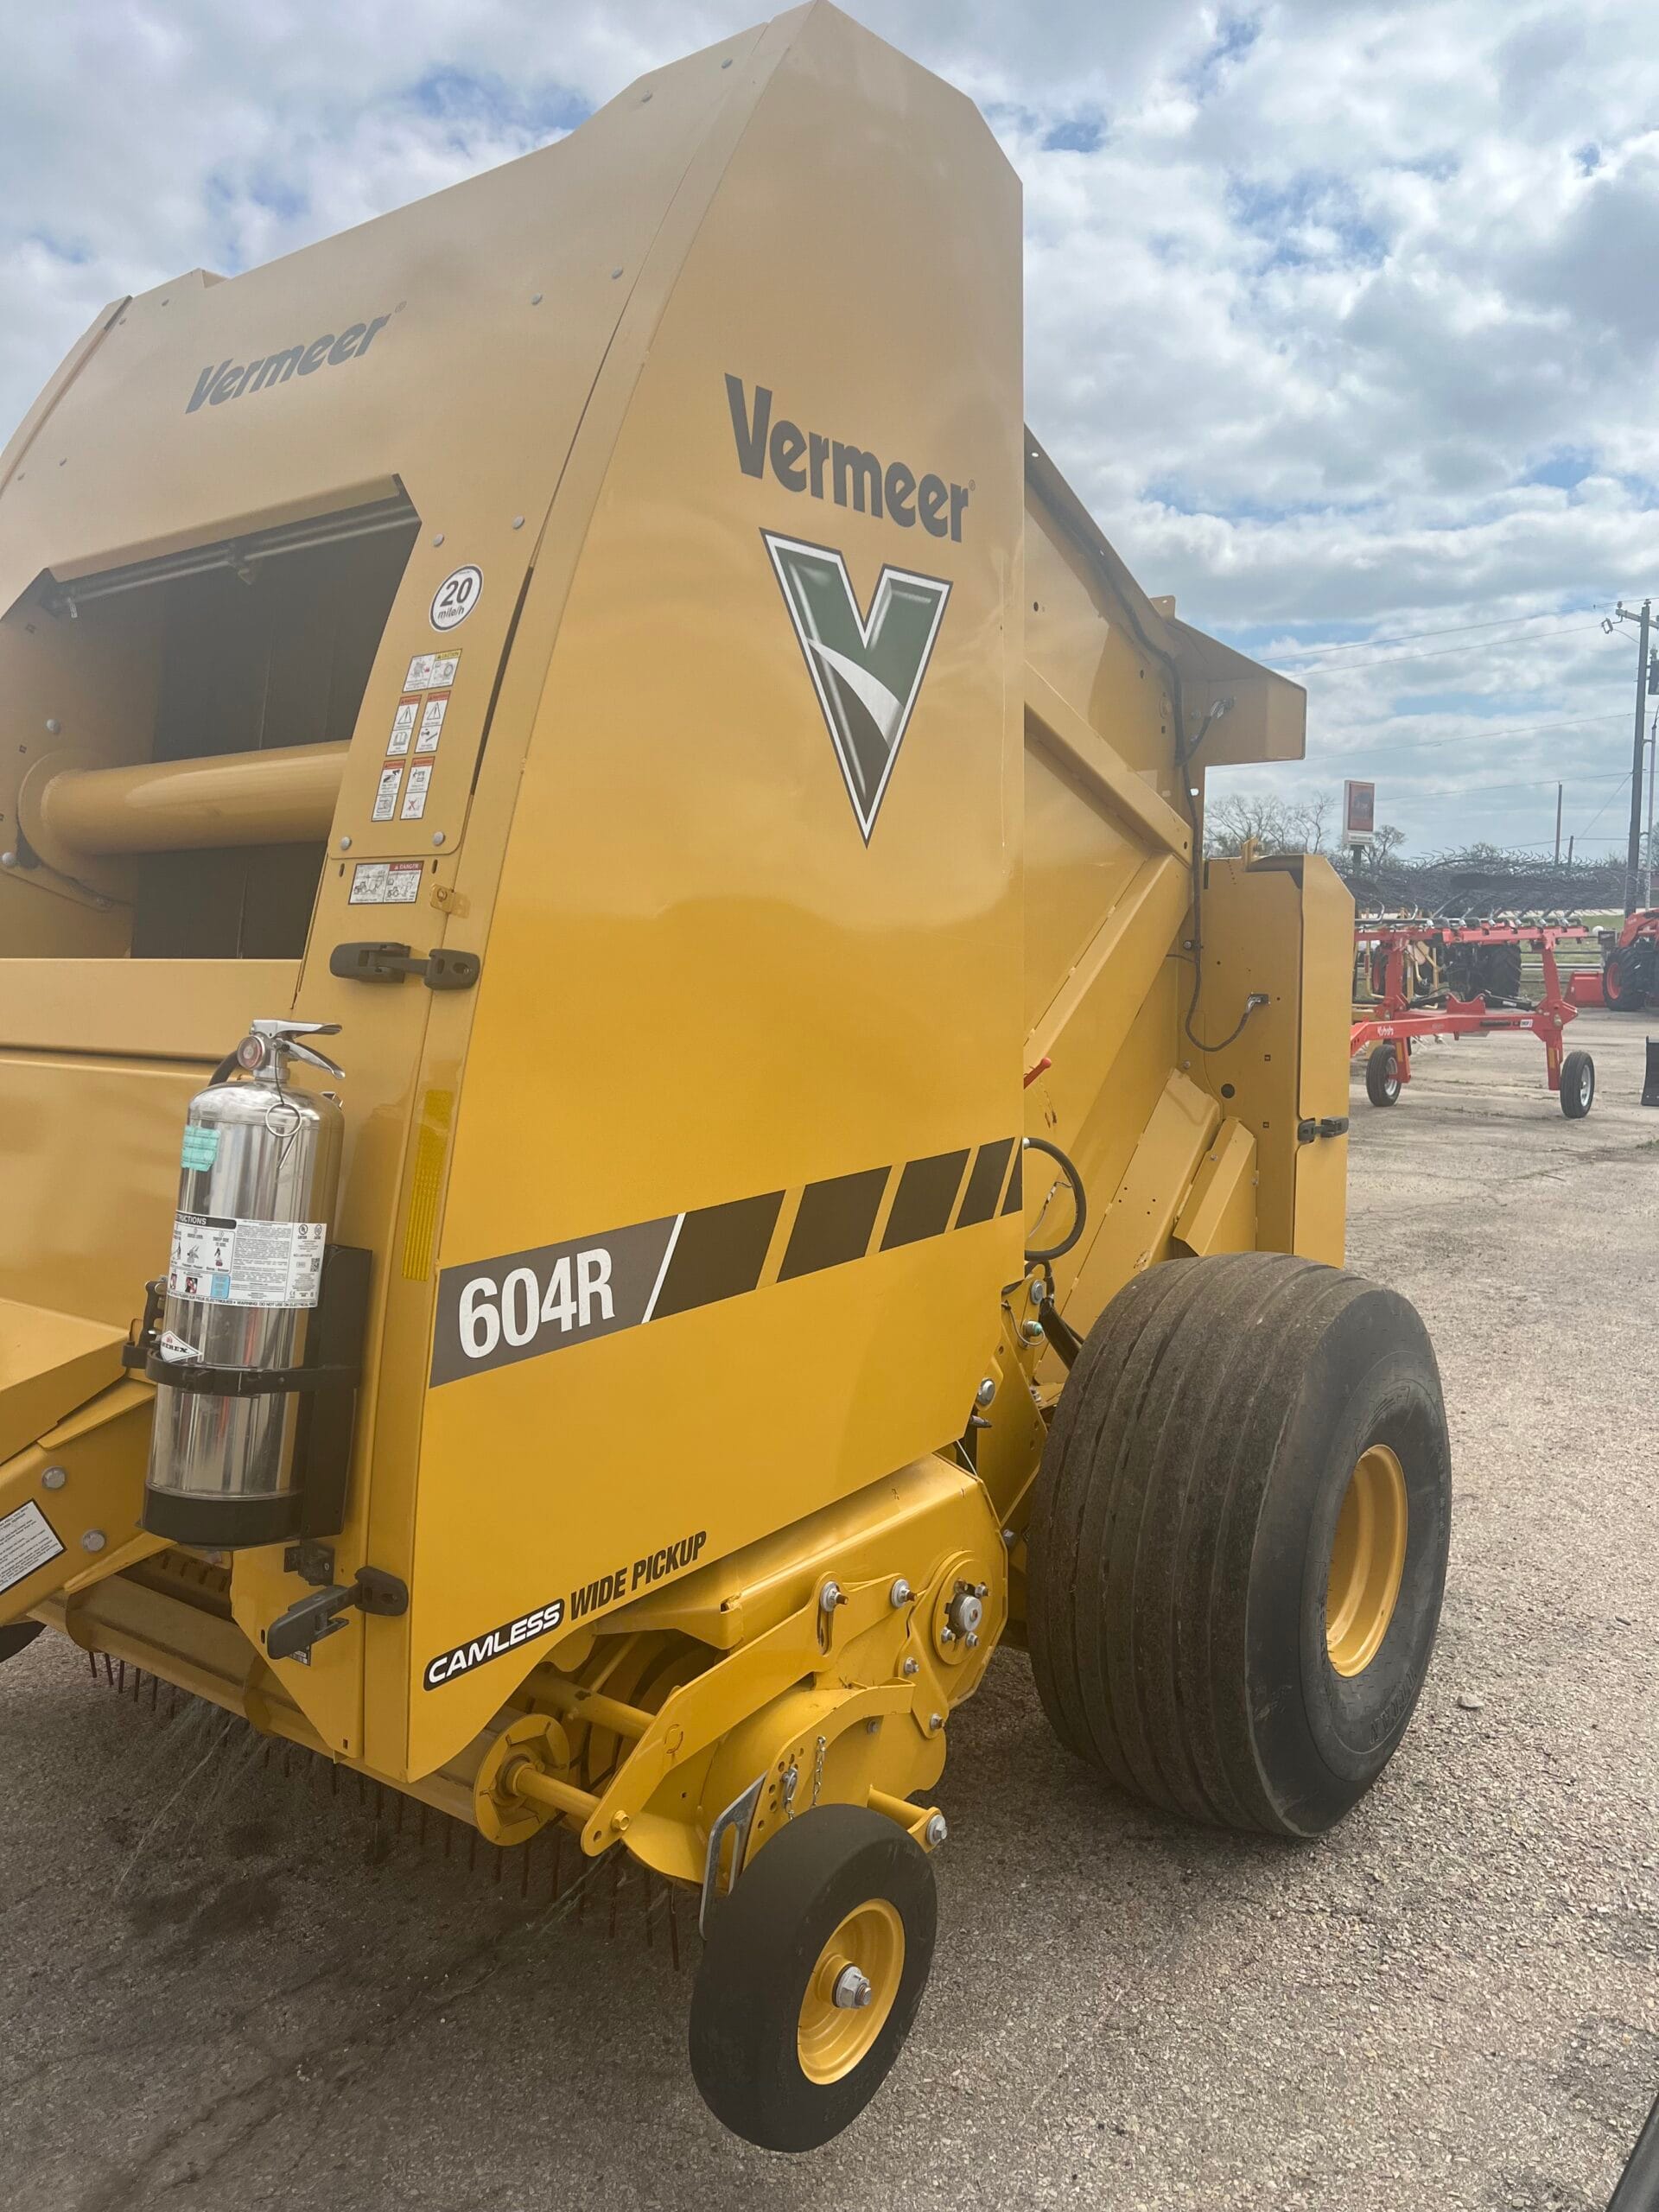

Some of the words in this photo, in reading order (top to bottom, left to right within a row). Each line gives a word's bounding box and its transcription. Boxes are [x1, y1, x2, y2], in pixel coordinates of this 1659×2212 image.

[185, 313, 391, 414] Vermeer
[724, 372, 969, 543] Vermeer
[437, 606, 464, 619] mile/h
[440, 577, 473, 607] 20
[459, 1248, 615, 1358] 604R
[429, 1603, 561, 1683] CAMLESS
[570, 1567, 627, 1621] WIDE
[631, 1531, 706, 1592] PICKUP
